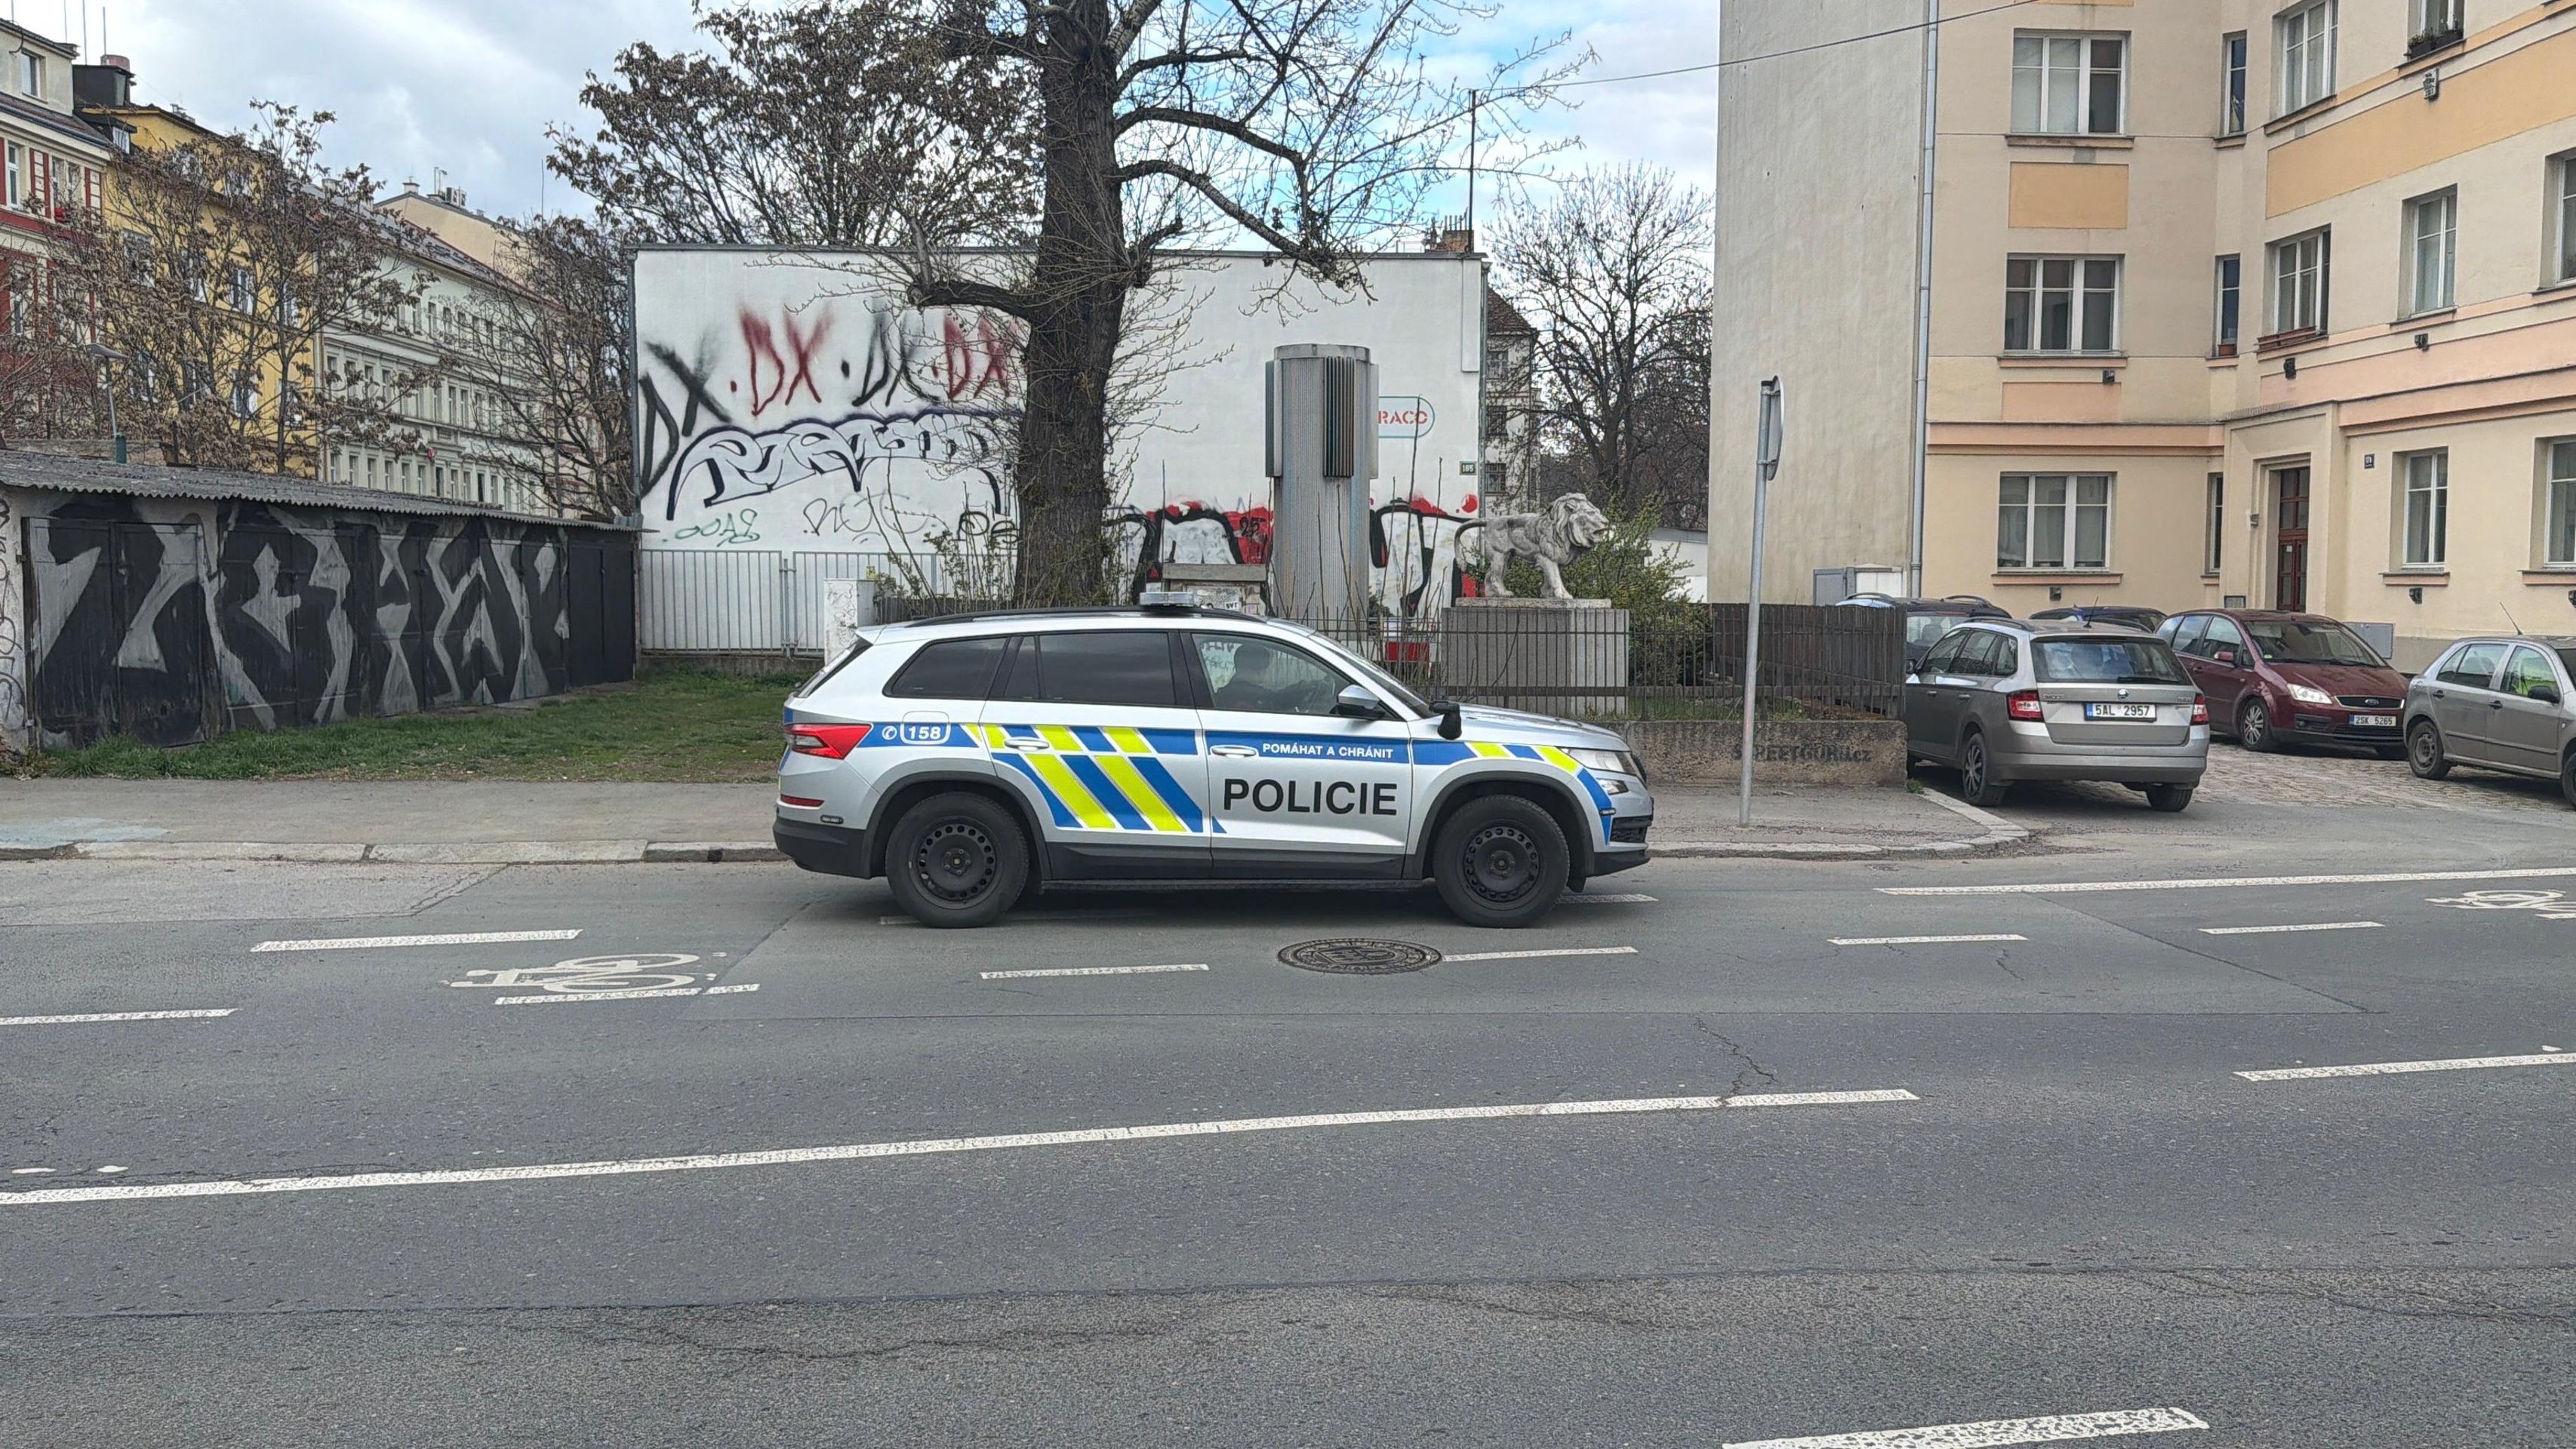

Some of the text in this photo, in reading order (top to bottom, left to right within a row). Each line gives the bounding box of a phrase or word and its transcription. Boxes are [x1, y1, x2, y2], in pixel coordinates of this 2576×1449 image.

[2094, 703, 2151, 717] 5AL 2957
[908, 725, 942, 740] 158
[1262, 742, 1394, 759] POMÁHAT A CHRÁNIT
[1223, 778, 1398, 816] POLICIE
